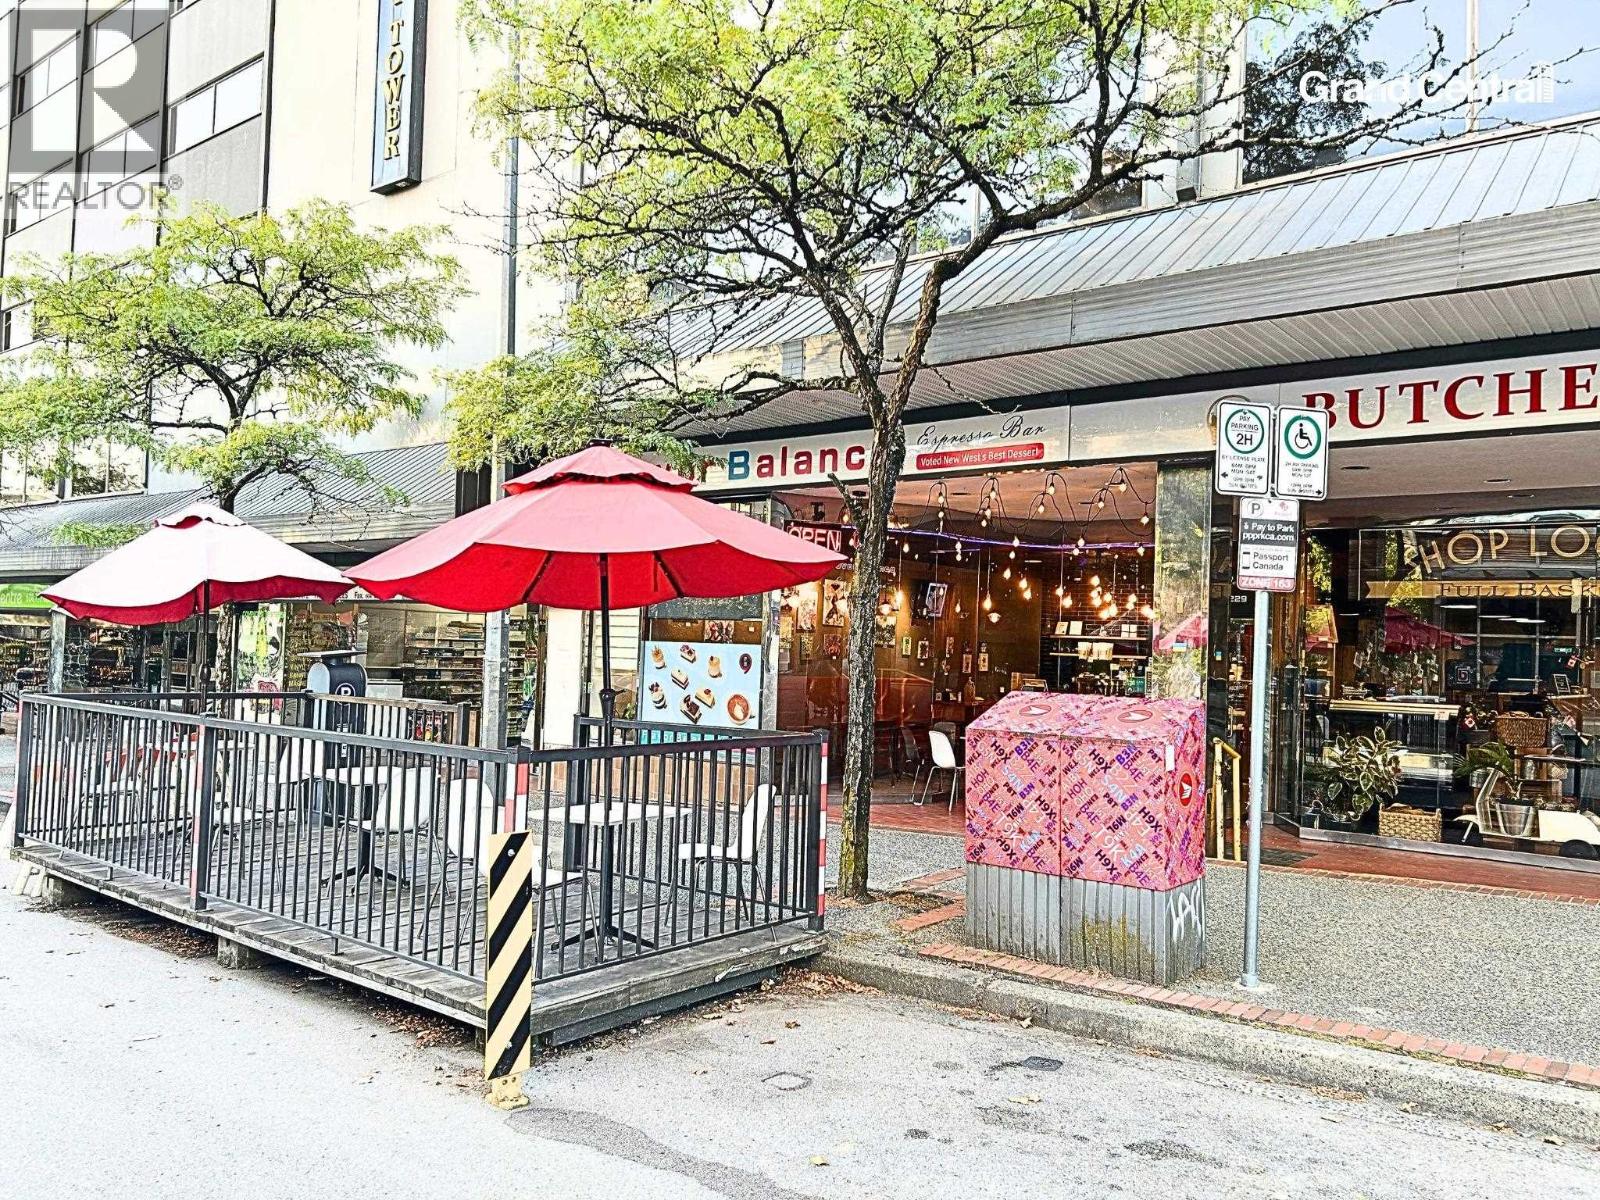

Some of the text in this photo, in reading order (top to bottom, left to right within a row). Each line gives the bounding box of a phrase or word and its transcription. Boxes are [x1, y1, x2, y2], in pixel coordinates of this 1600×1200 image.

[382, 19, 406, 161] TOWER
[917, 415, 1047, 452] Espresso Bar
[1231, 422, 1259, 431] PARKING
[1236, 433, 1253, 446] 2H
[920, 447, 1039, 467] Voted New West's Best Dessert
[1251, 523, 1294, 535] Pay to Park
[1530, 524, 1600, 558] LO
[1252, 561, 1284, 571] Canada
[1253, 552, 1289, 562] Passport
[1241, 576, 1270, 587] ZONE
[1440, 582, 1507, 597] FULL
[991, 740, 1010, 764] H9X
[1014, 737, 1035, 756] B3N
[1115, 743, 1138, 765] B3N
[1147, 749, 1162, 763] P8T
[1021, 752, 1041, 774] B4E
[1088, 749, 1112, 774] H9X
[1122, 761, 1144, 783] B4E
[1019, 782, 1035, 799] B3N
[1103, 792, 1118, 808] P8T
[982, 793, 1001, 813] B4E
[1035, 794, 1056, 820] H9X
[1120, 793, 1139, 811] B3N
[1080, 803, 1100, 826] B4E
[1106, 815, 1127, 833] M9L
[1138, 806, 1162, 832] H9X
[1062, 836, 1077, 852] P8T
[1026, 849, 1046, 870] B4E
[1095, 849, 1119, 875] H9X
[1128, 862, 1150, 886] B4E
